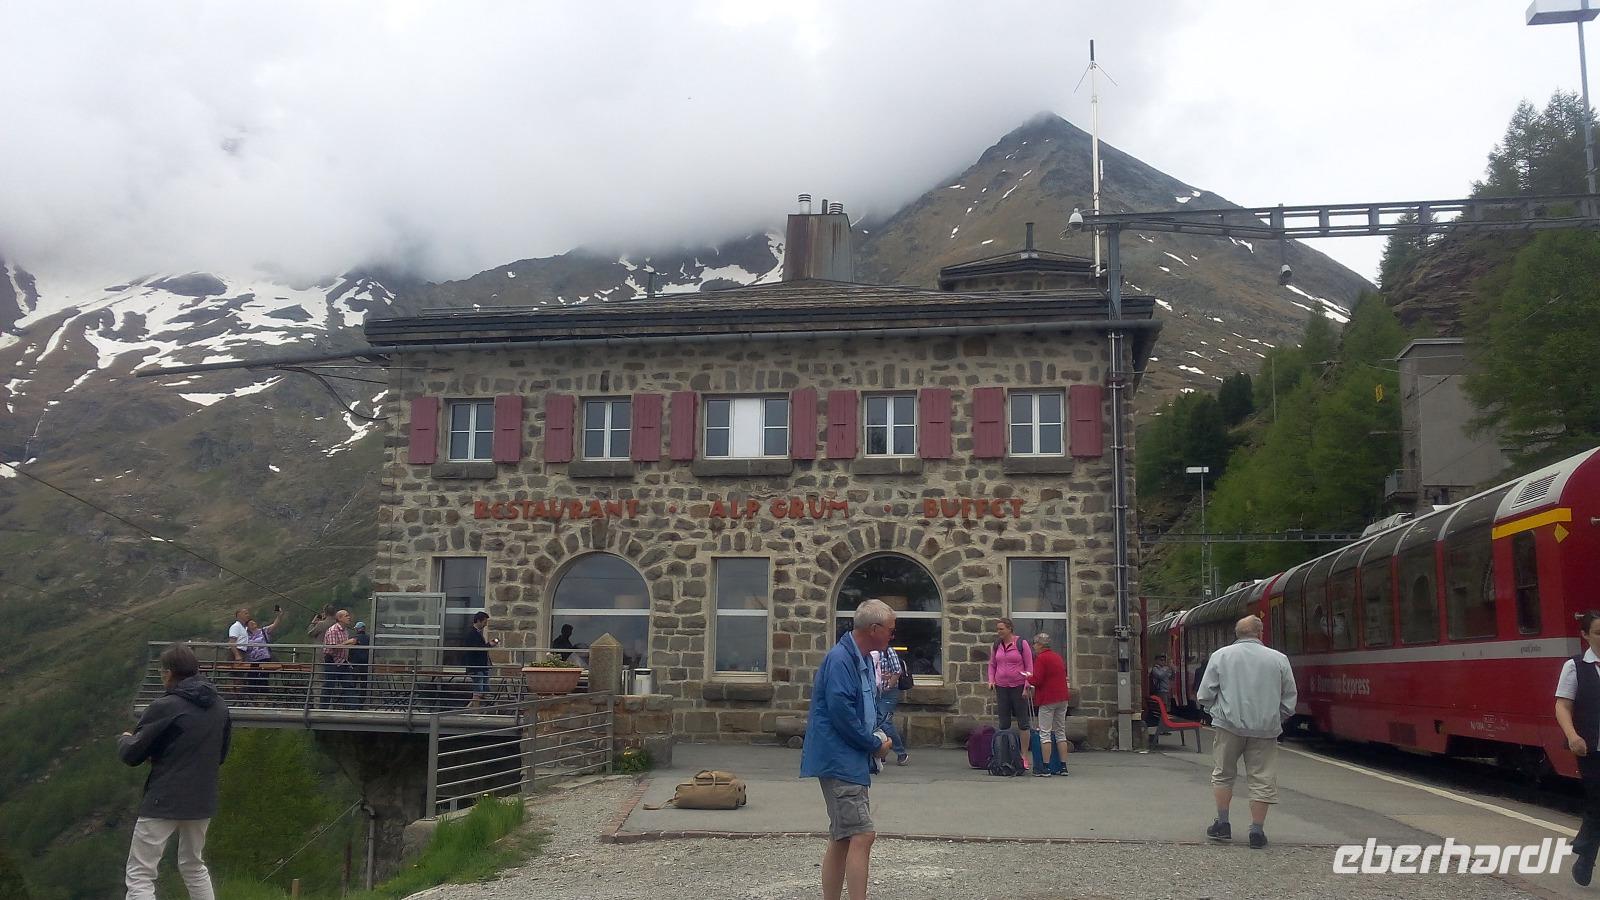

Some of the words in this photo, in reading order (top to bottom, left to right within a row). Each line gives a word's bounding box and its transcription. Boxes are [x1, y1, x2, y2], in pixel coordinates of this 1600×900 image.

[474, 499, 639, 519] RESTAURANT
[709, 499, 761, 519] ALP
[923, 497, 1024, 519] BUFFET
[1342, 673, 1370, 699] Express
